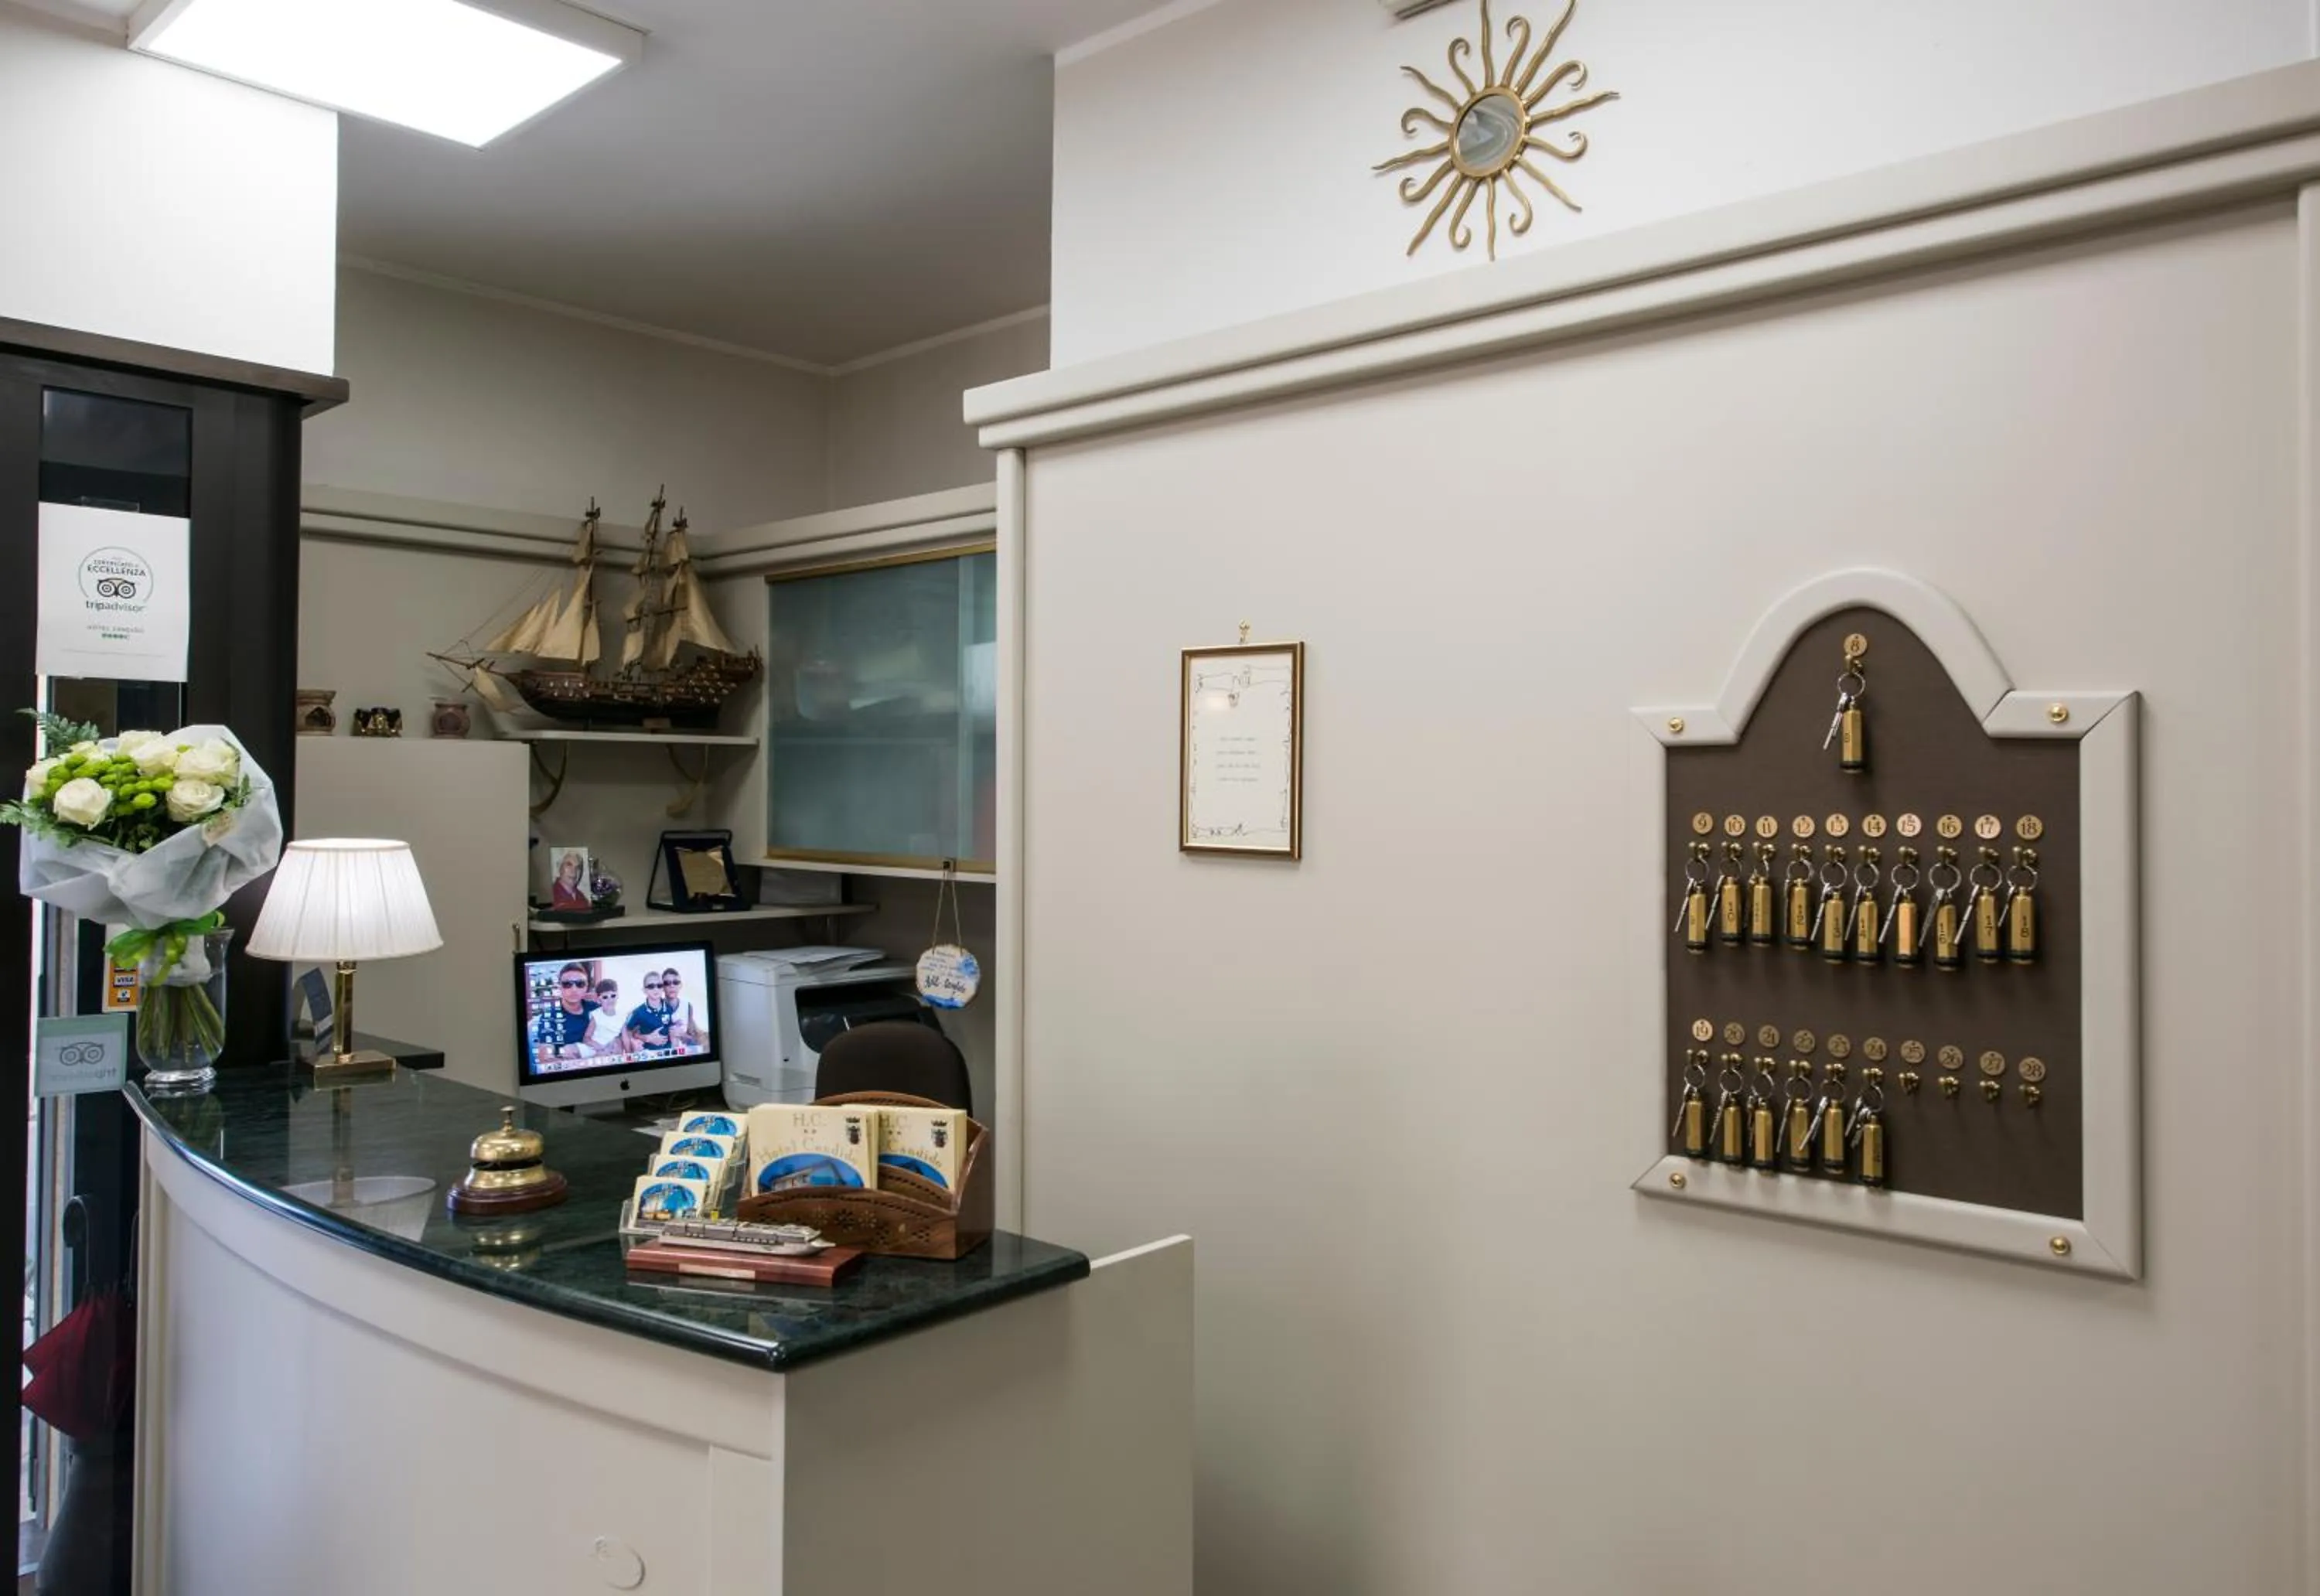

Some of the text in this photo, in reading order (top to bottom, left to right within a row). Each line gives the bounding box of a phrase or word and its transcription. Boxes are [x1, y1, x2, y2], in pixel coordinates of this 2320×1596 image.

[87, 564, 146, 576] ECCELLENZA
[87, 600, 147, 612] tripadvisor
[1851, 639, 1859, 651] 8
[1698, 817, 1707, 830] 9
[1728, 819, 1741, 833] 10
[1762, 821, 1771, 834] 11
[1796, 820, 1810, 834] 12
[1868, 820, 1882, 833] 14
[1902, 818, 1916, 834] 15
[1941, 820, 1957, 834] 16
[1980, 820, 1994, 834] 17
[2021, 821, 2038, 835] 18
[1695, 1024, 1709, 1038] 19
[1728, 1027, 1742, 1041] 20
[1762, 1029, 1776, 1043] 21
[1868, 1042, 1884, 1056] 24
[1905, 1045, 1923, 1060] 25
[1943, 1051, 1960, 1066] 26
[1984, 1057, 2001, 1071] 27
[2025, 1062, 2043, 1077] 28
[792, 1111, 827, 1127] H.C.
